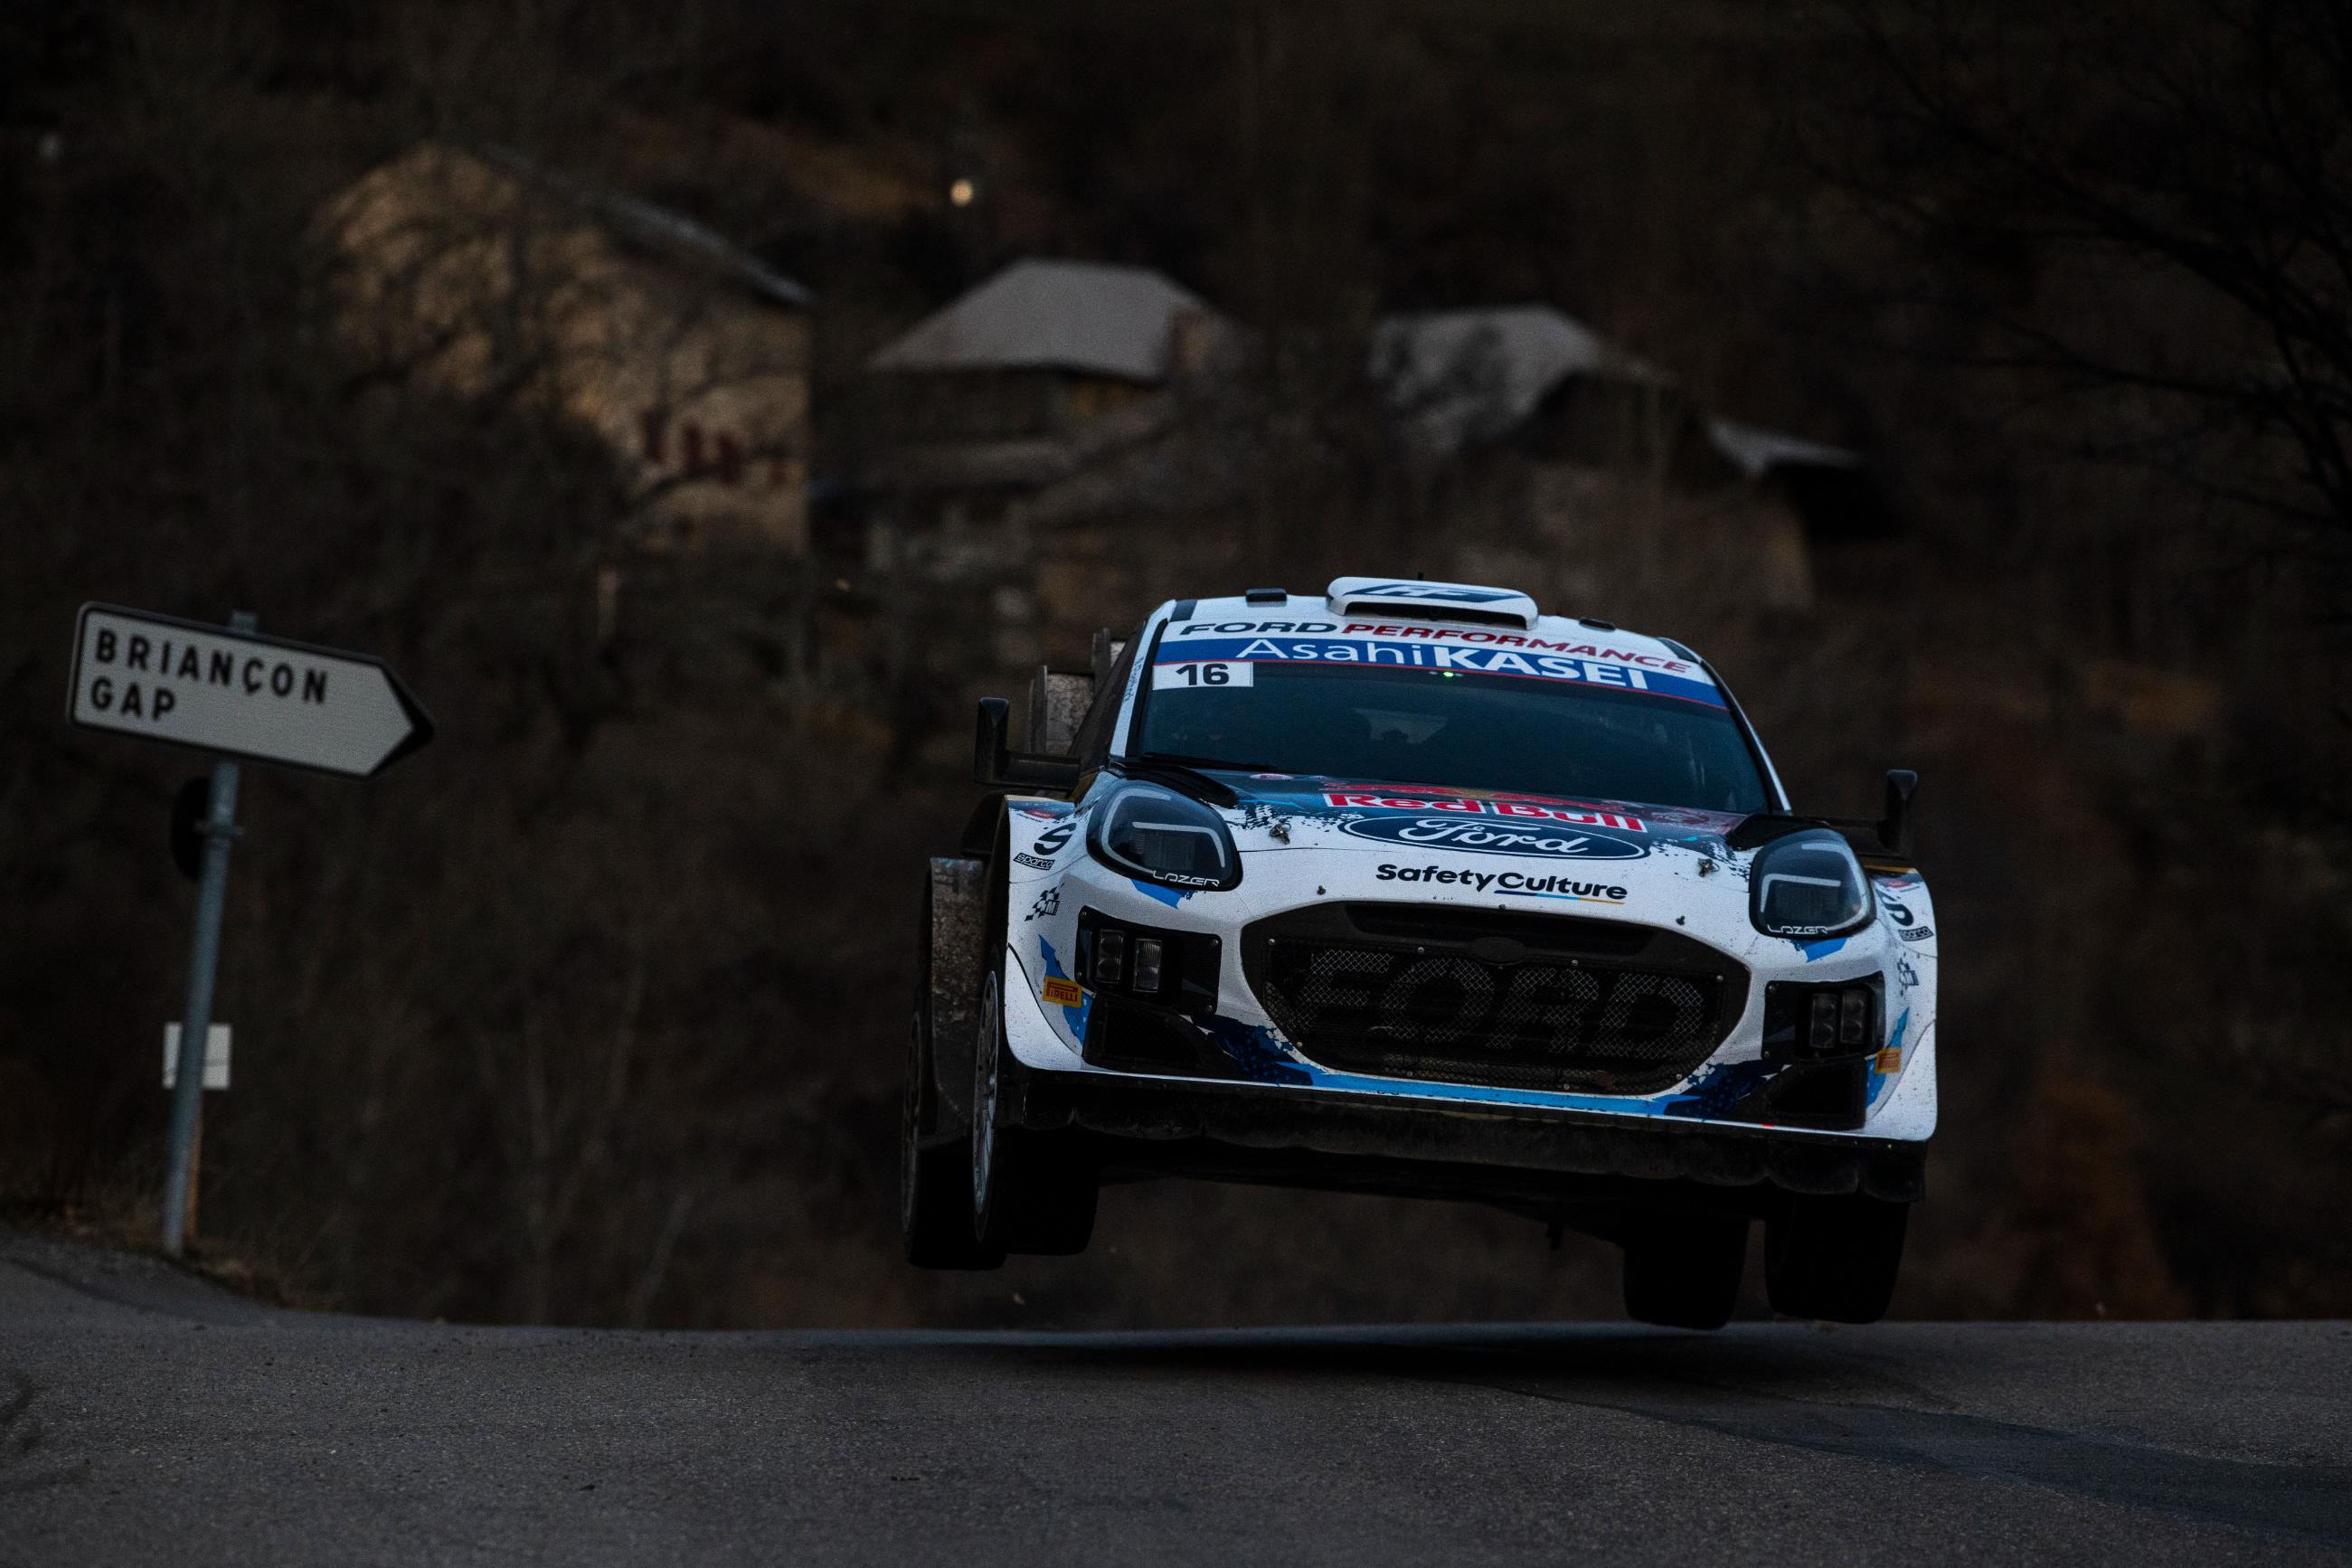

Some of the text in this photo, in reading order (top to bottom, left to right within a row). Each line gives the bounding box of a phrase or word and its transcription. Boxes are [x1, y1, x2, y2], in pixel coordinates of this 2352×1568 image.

[1179, 622, 1692, 673] FORD PERFORMANCE
[97, 630, 327, 704] BRIANÇON
[1176, 663, 1230, 686] 16
[92, 679, 175, 720] GAP
[1323, 793, 1487, 815] Red
[1399, 818, 1591, 854] Ford
[1015, 853, 1055, 871] sparco
[1376, 864, 1628, 900] SafetyCulture
[1046, 982, 1078, 1002] PIRELLI
[1288, 949, 1707, 1059] FORD
